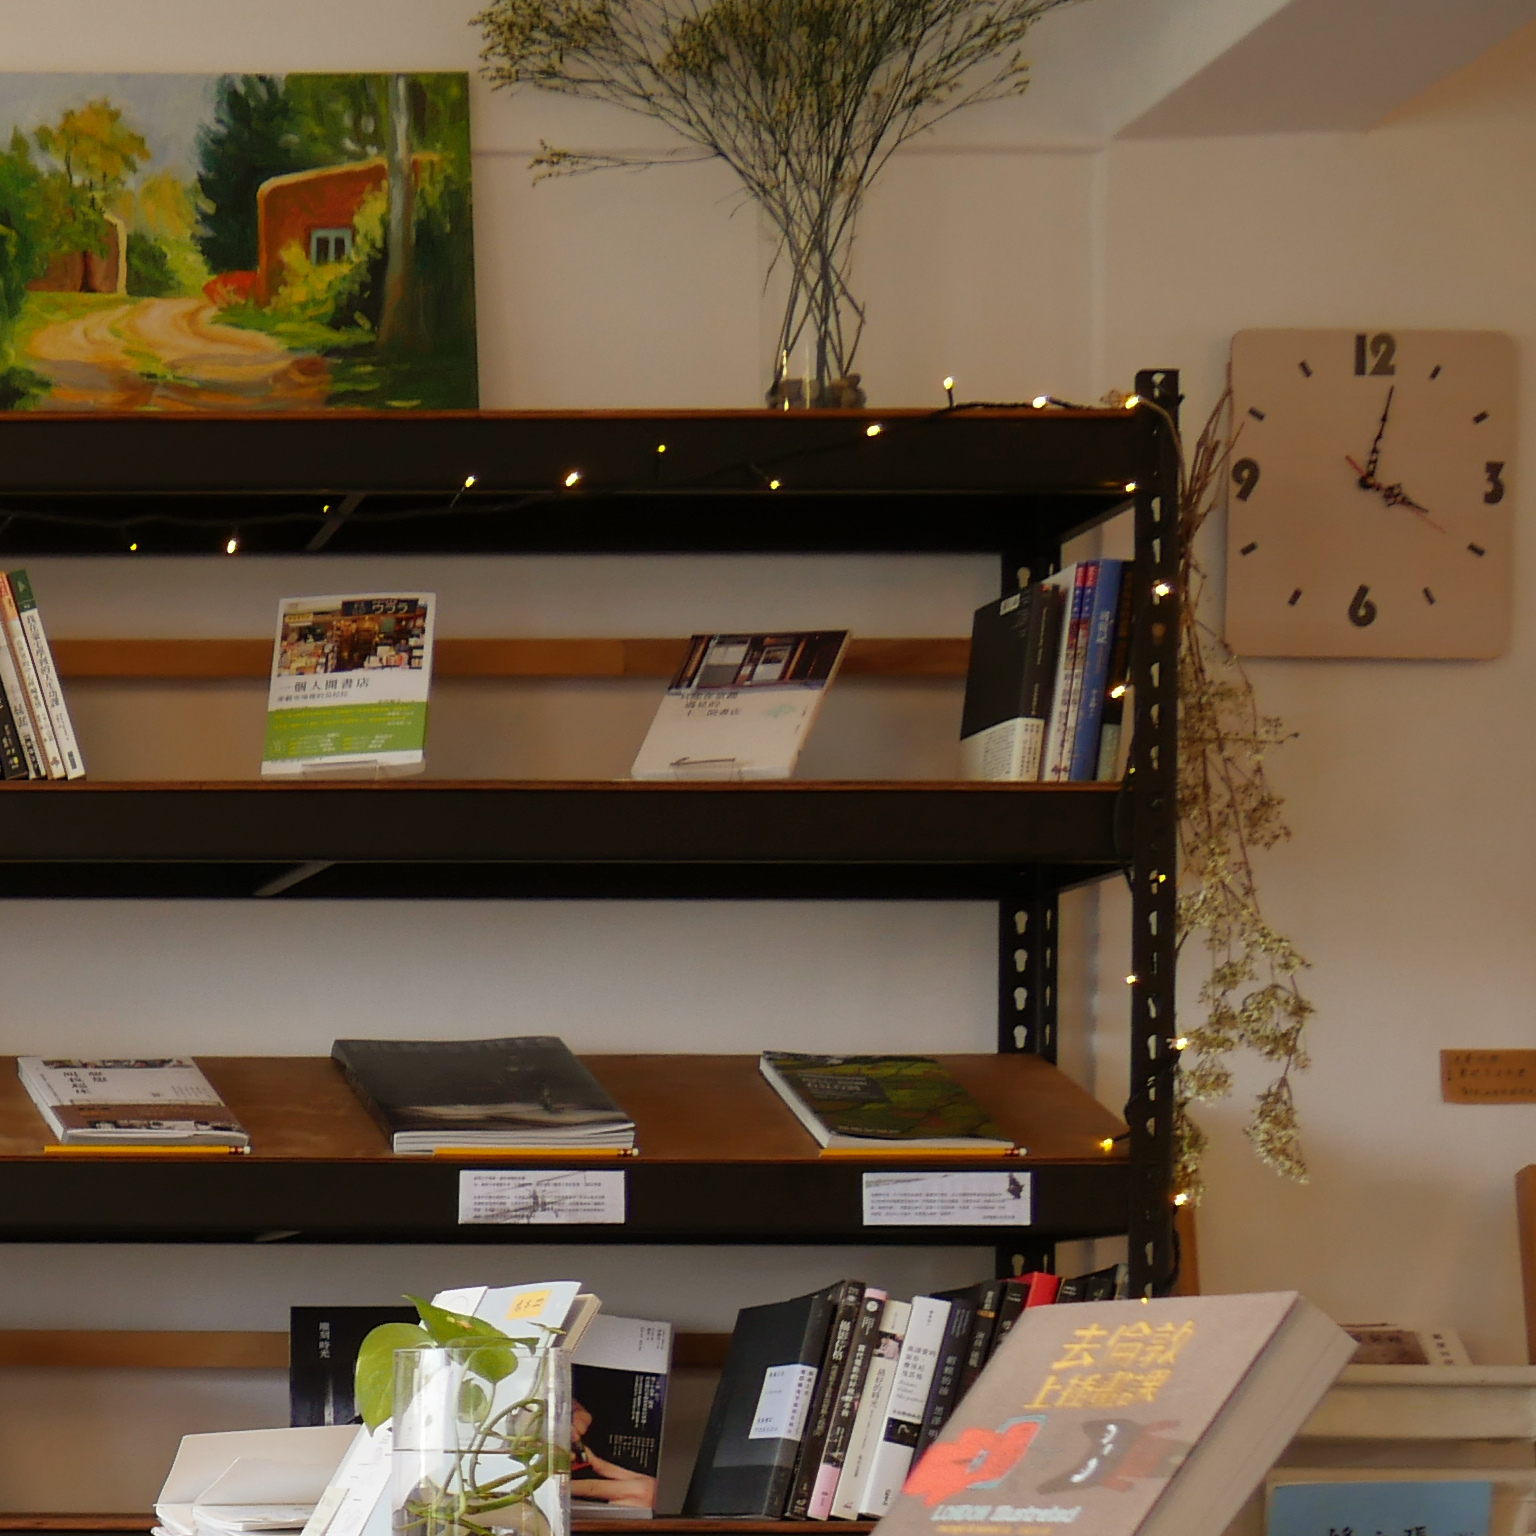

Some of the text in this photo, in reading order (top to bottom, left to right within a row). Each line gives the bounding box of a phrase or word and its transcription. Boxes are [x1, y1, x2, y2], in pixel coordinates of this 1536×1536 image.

[1354, 332, 1396, 376] 12
[1232, 457, 1261, 502] 9
[1483, 461, 1506, 504] 3
[1348, 584, 1376, 627] 6
[278, 678, 370, 694] 一個人開書店
[1052, 1319, 1196, 1372] 去倫敦
[930, 1504, 1081, 1523] LONDON Illustrated
